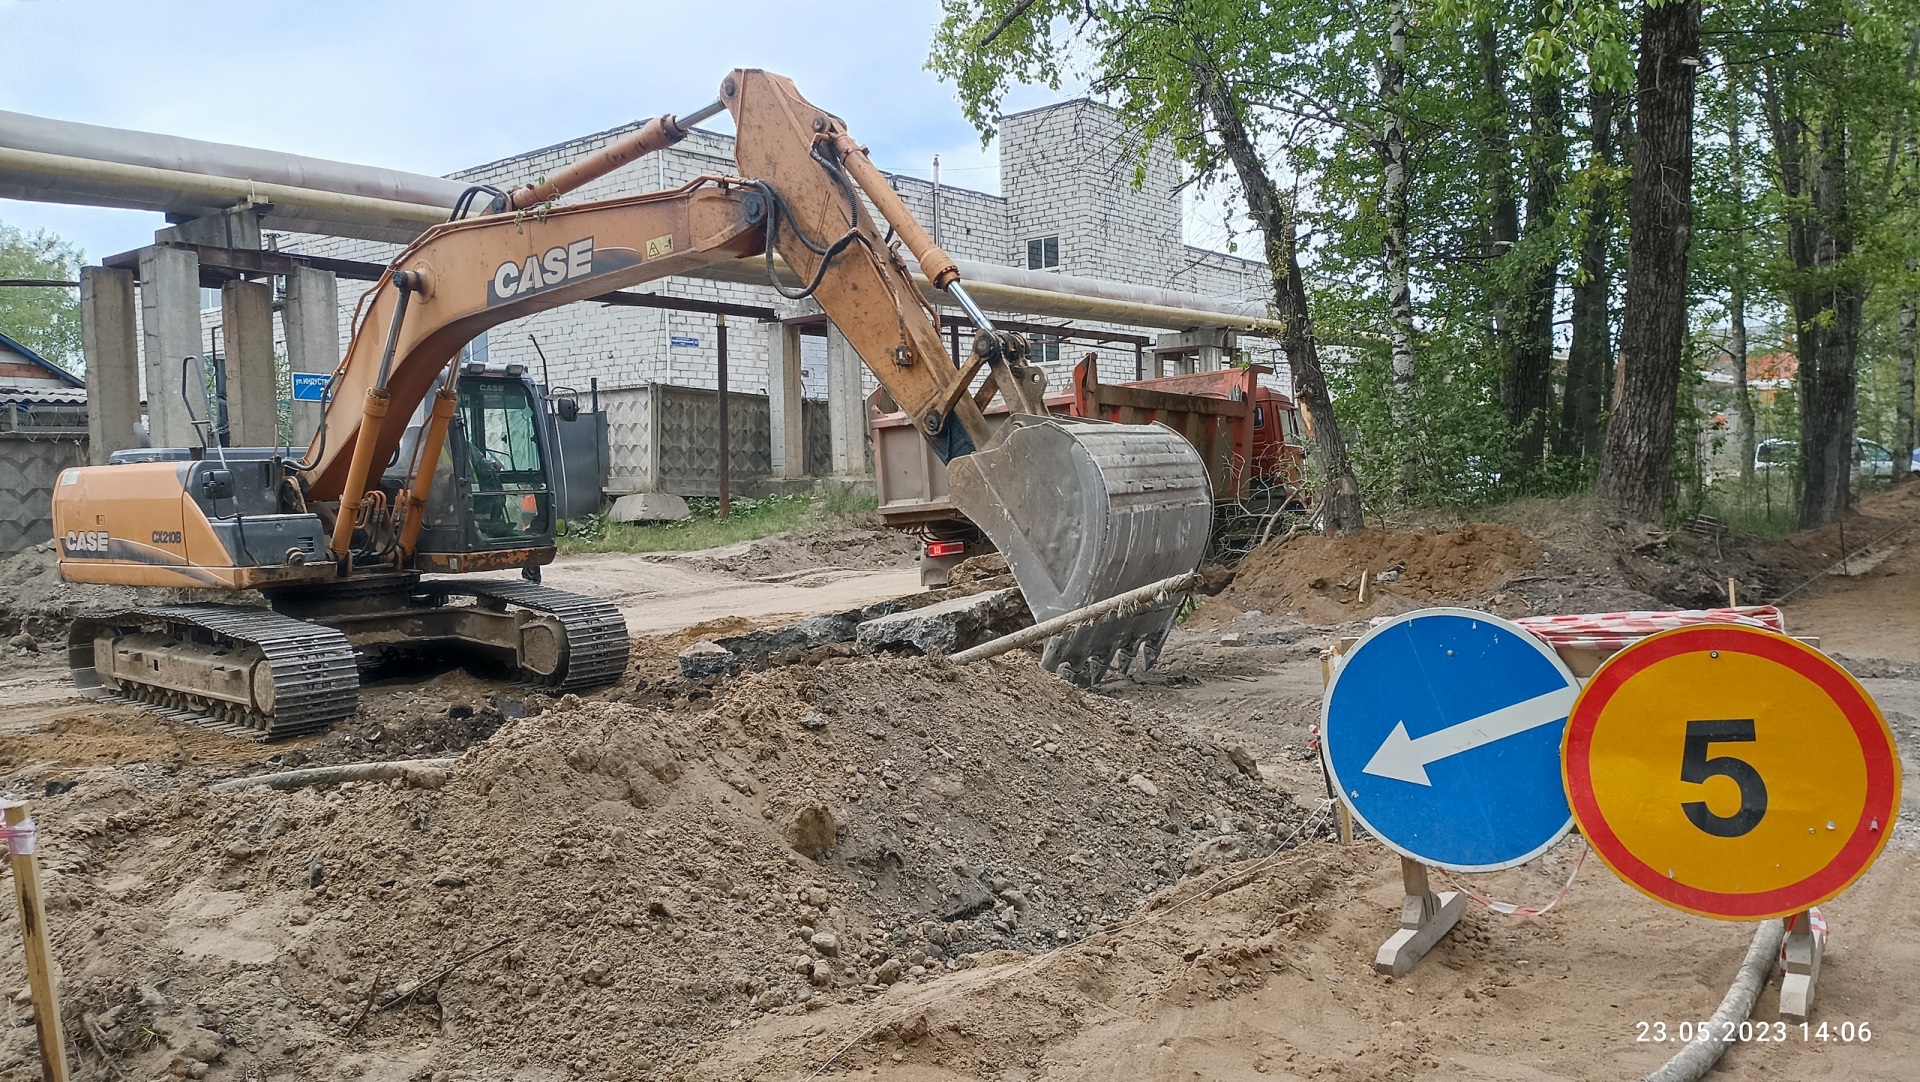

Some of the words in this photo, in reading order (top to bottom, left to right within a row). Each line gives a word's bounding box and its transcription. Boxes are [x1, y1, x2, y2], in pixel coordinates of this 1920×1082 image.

[494, 237, 593, 298] CASE
[479, 384, 504, 392] CASE
[65, 530, 109, 552] CASE
[151, 530, 182, 544] CX210B
[1680, 718, 1769, 838] 5
